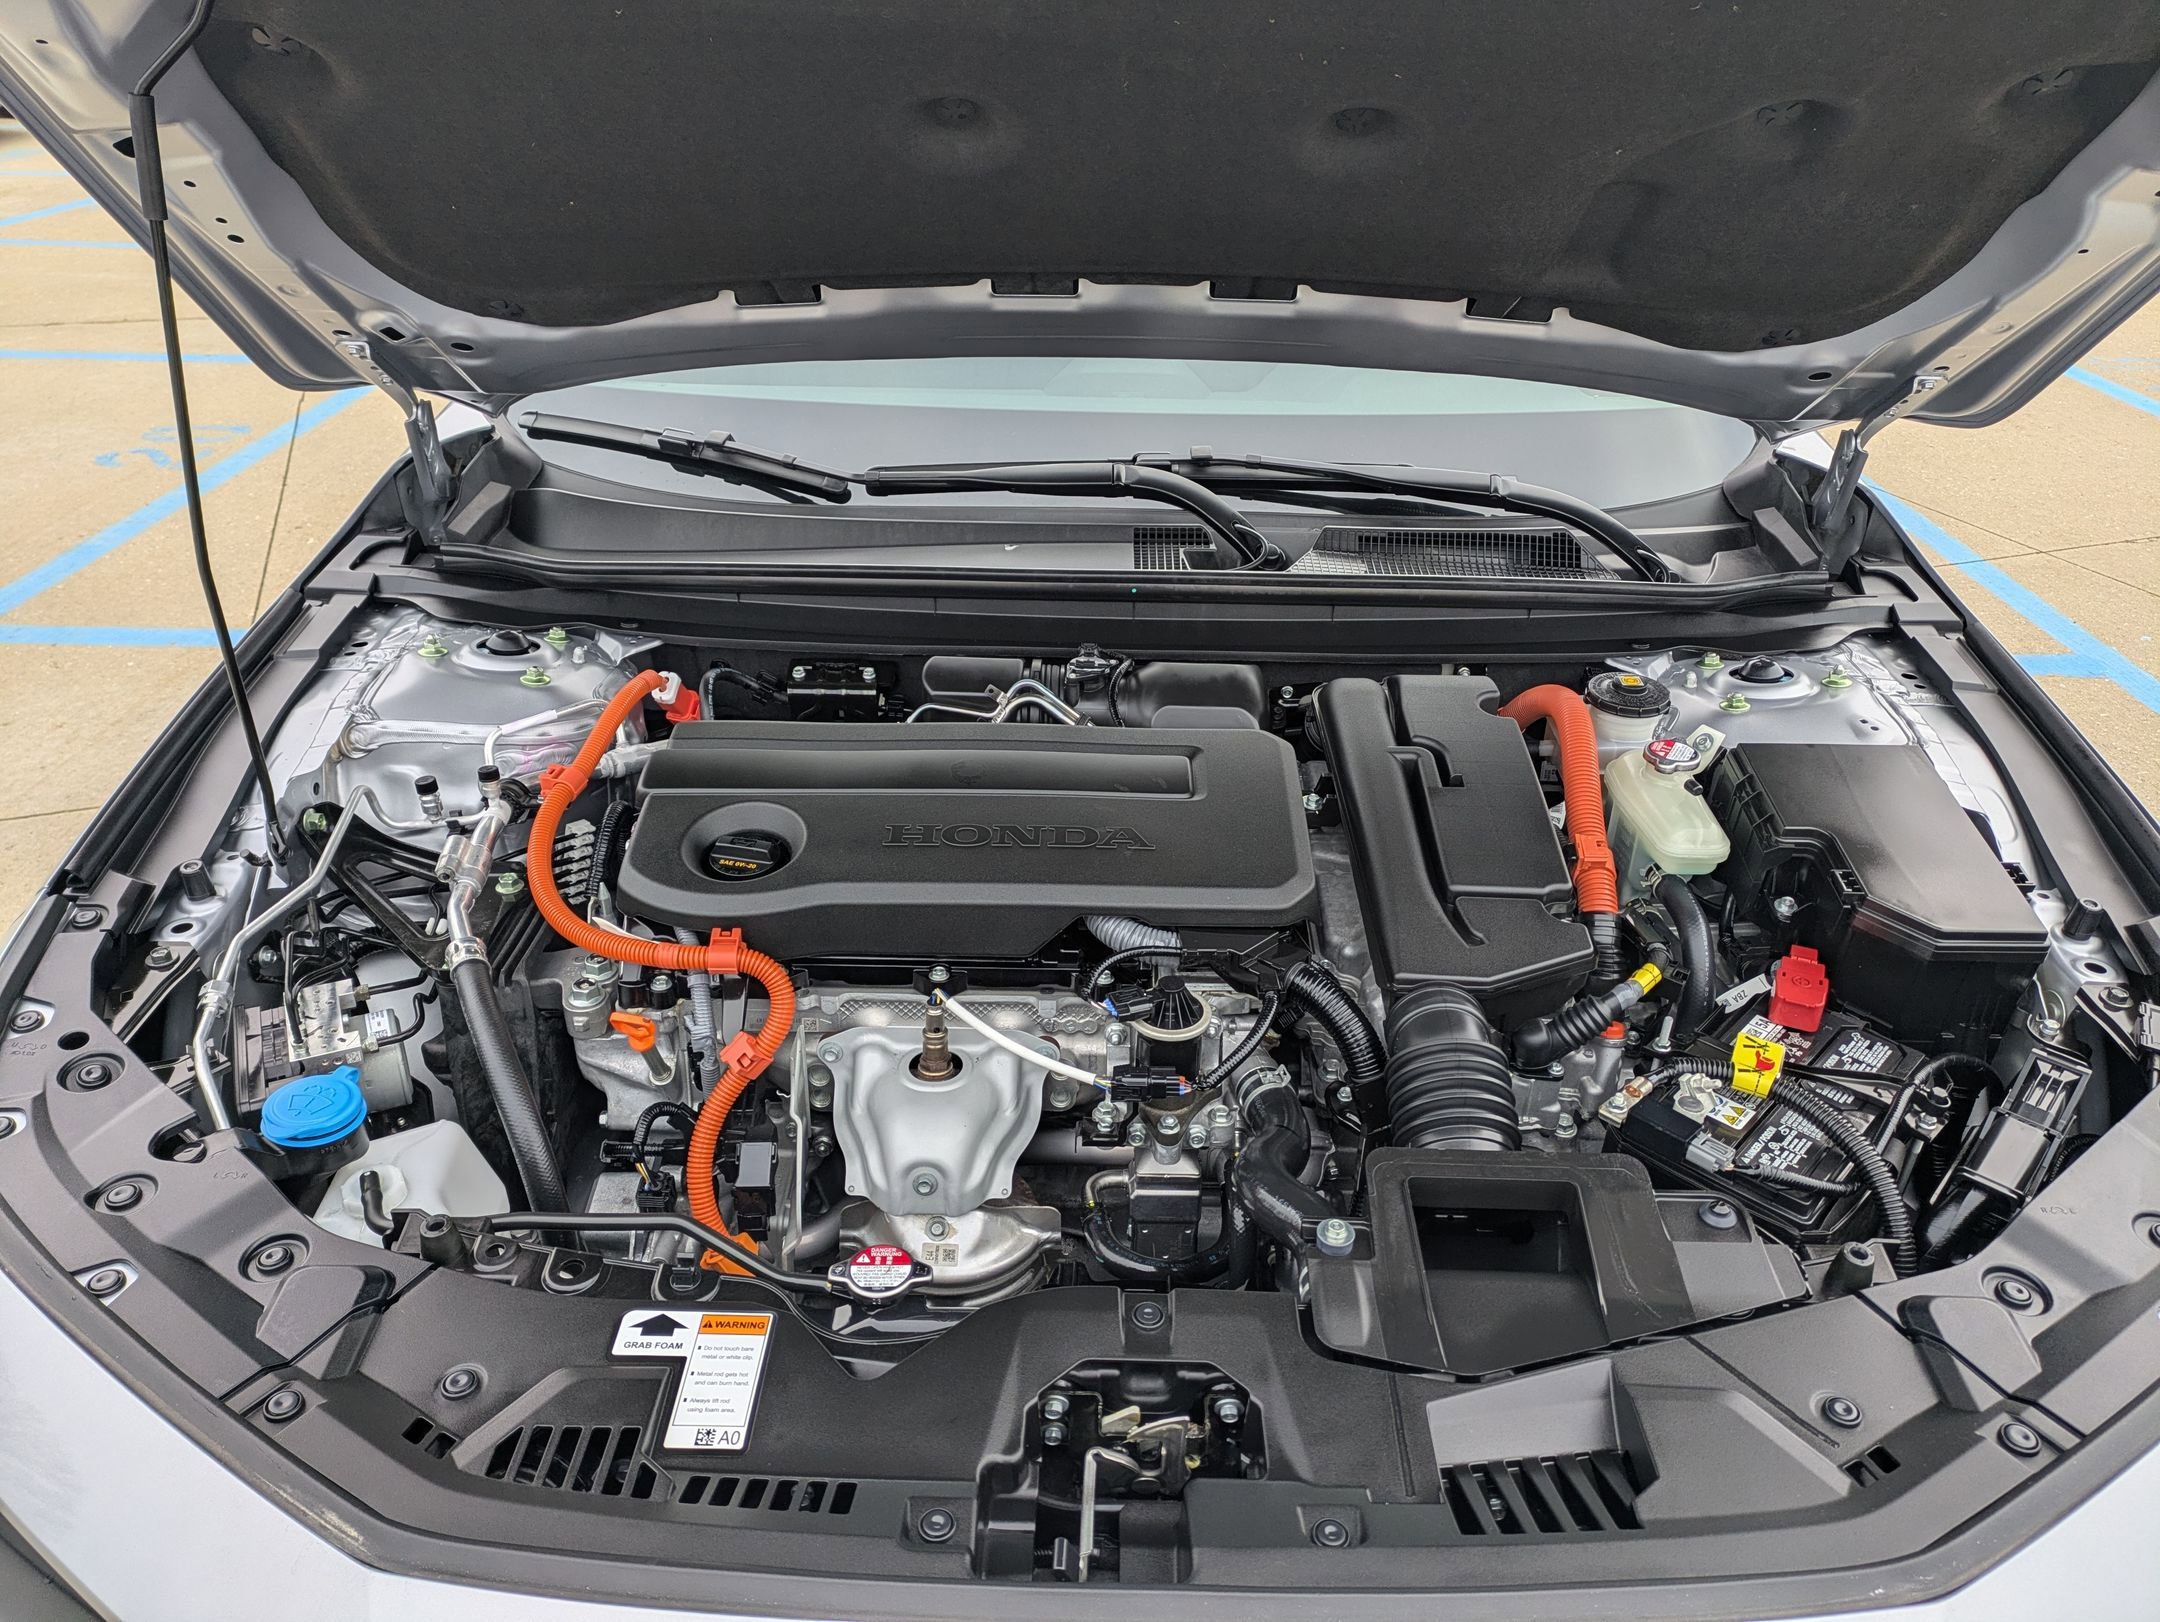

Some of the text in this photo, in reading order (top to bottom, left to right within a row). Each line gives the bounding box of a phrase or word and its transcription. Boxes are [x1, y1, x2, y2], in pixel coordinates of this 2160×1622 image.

[882, 823, 1156, 850] HONDA
[719, 859, 735, 867] SAE
[715, 1320, 765, 1330] WARNING
[623, 1341, 684, 1350] GRAB FOAM
